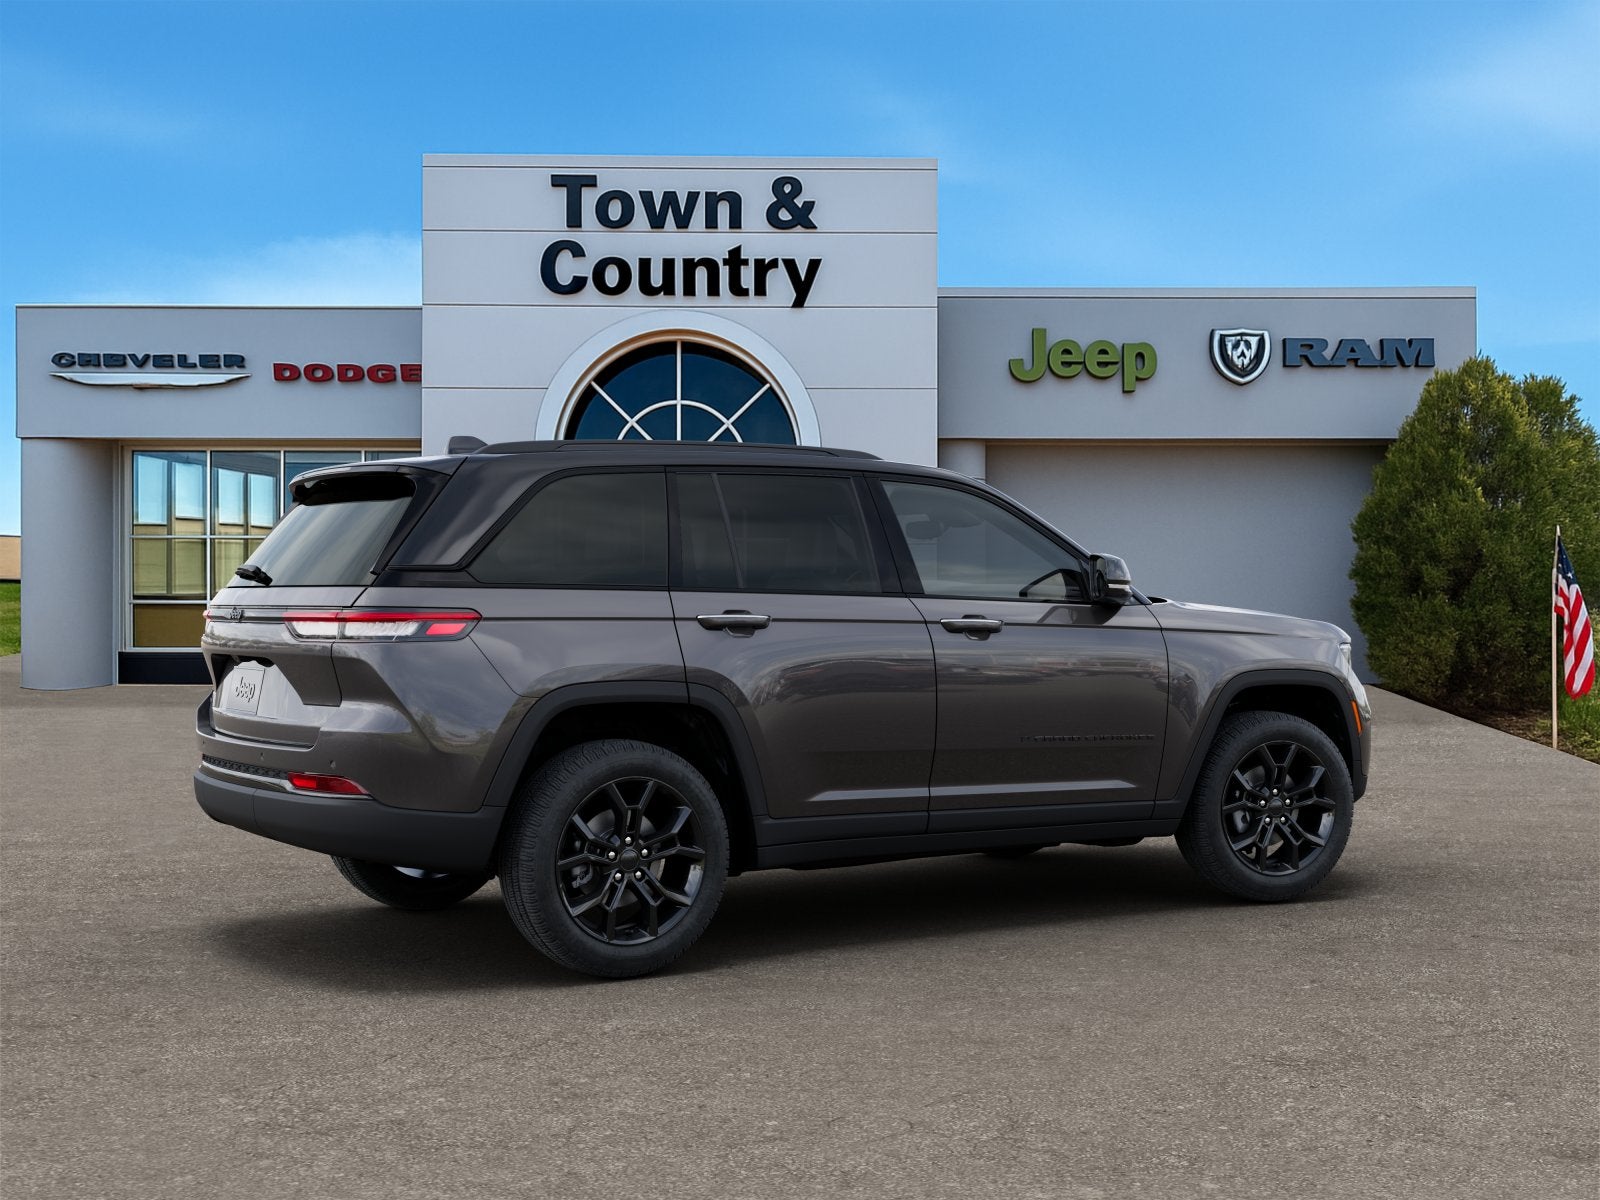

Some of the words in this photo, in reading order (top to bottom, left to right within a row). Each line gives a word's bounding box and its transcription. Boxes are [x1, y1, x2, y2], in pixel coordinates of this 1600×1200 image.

[551, 174, 742, 229] Town
[766, 176, 818, 229] &
[540, 239, 822, 308] Country
[273, 363, 422, 384] DODGE
[1009, 328, 1157, 392] Jeep
[1282, 337, 1435, 367] RAM
